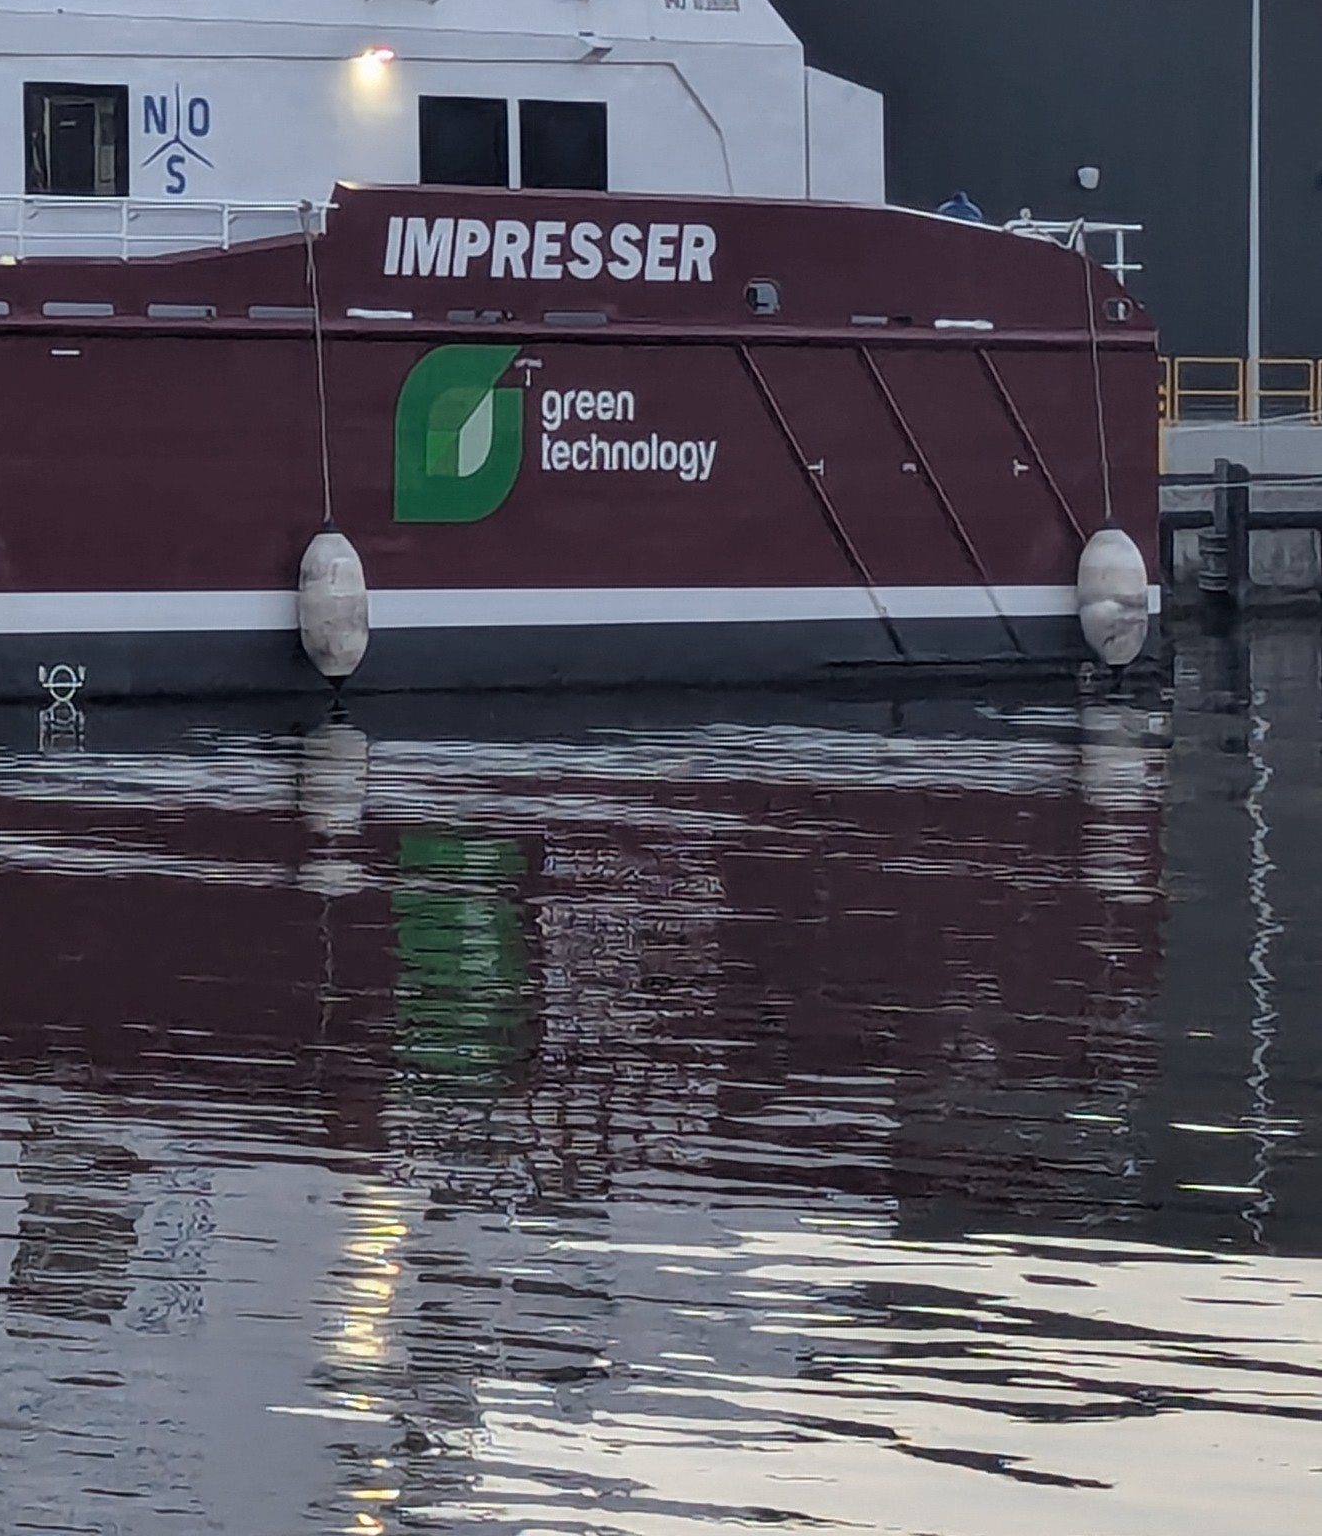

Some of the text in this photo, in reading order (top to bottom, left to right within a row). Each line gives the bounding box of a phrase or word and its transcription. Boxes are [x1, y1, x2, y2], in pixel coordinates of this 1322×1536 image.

[384, 216, 716, 282] IMPRESSER
[541, 389, 635, 431] green
[541, 432, 717, 482] technology
